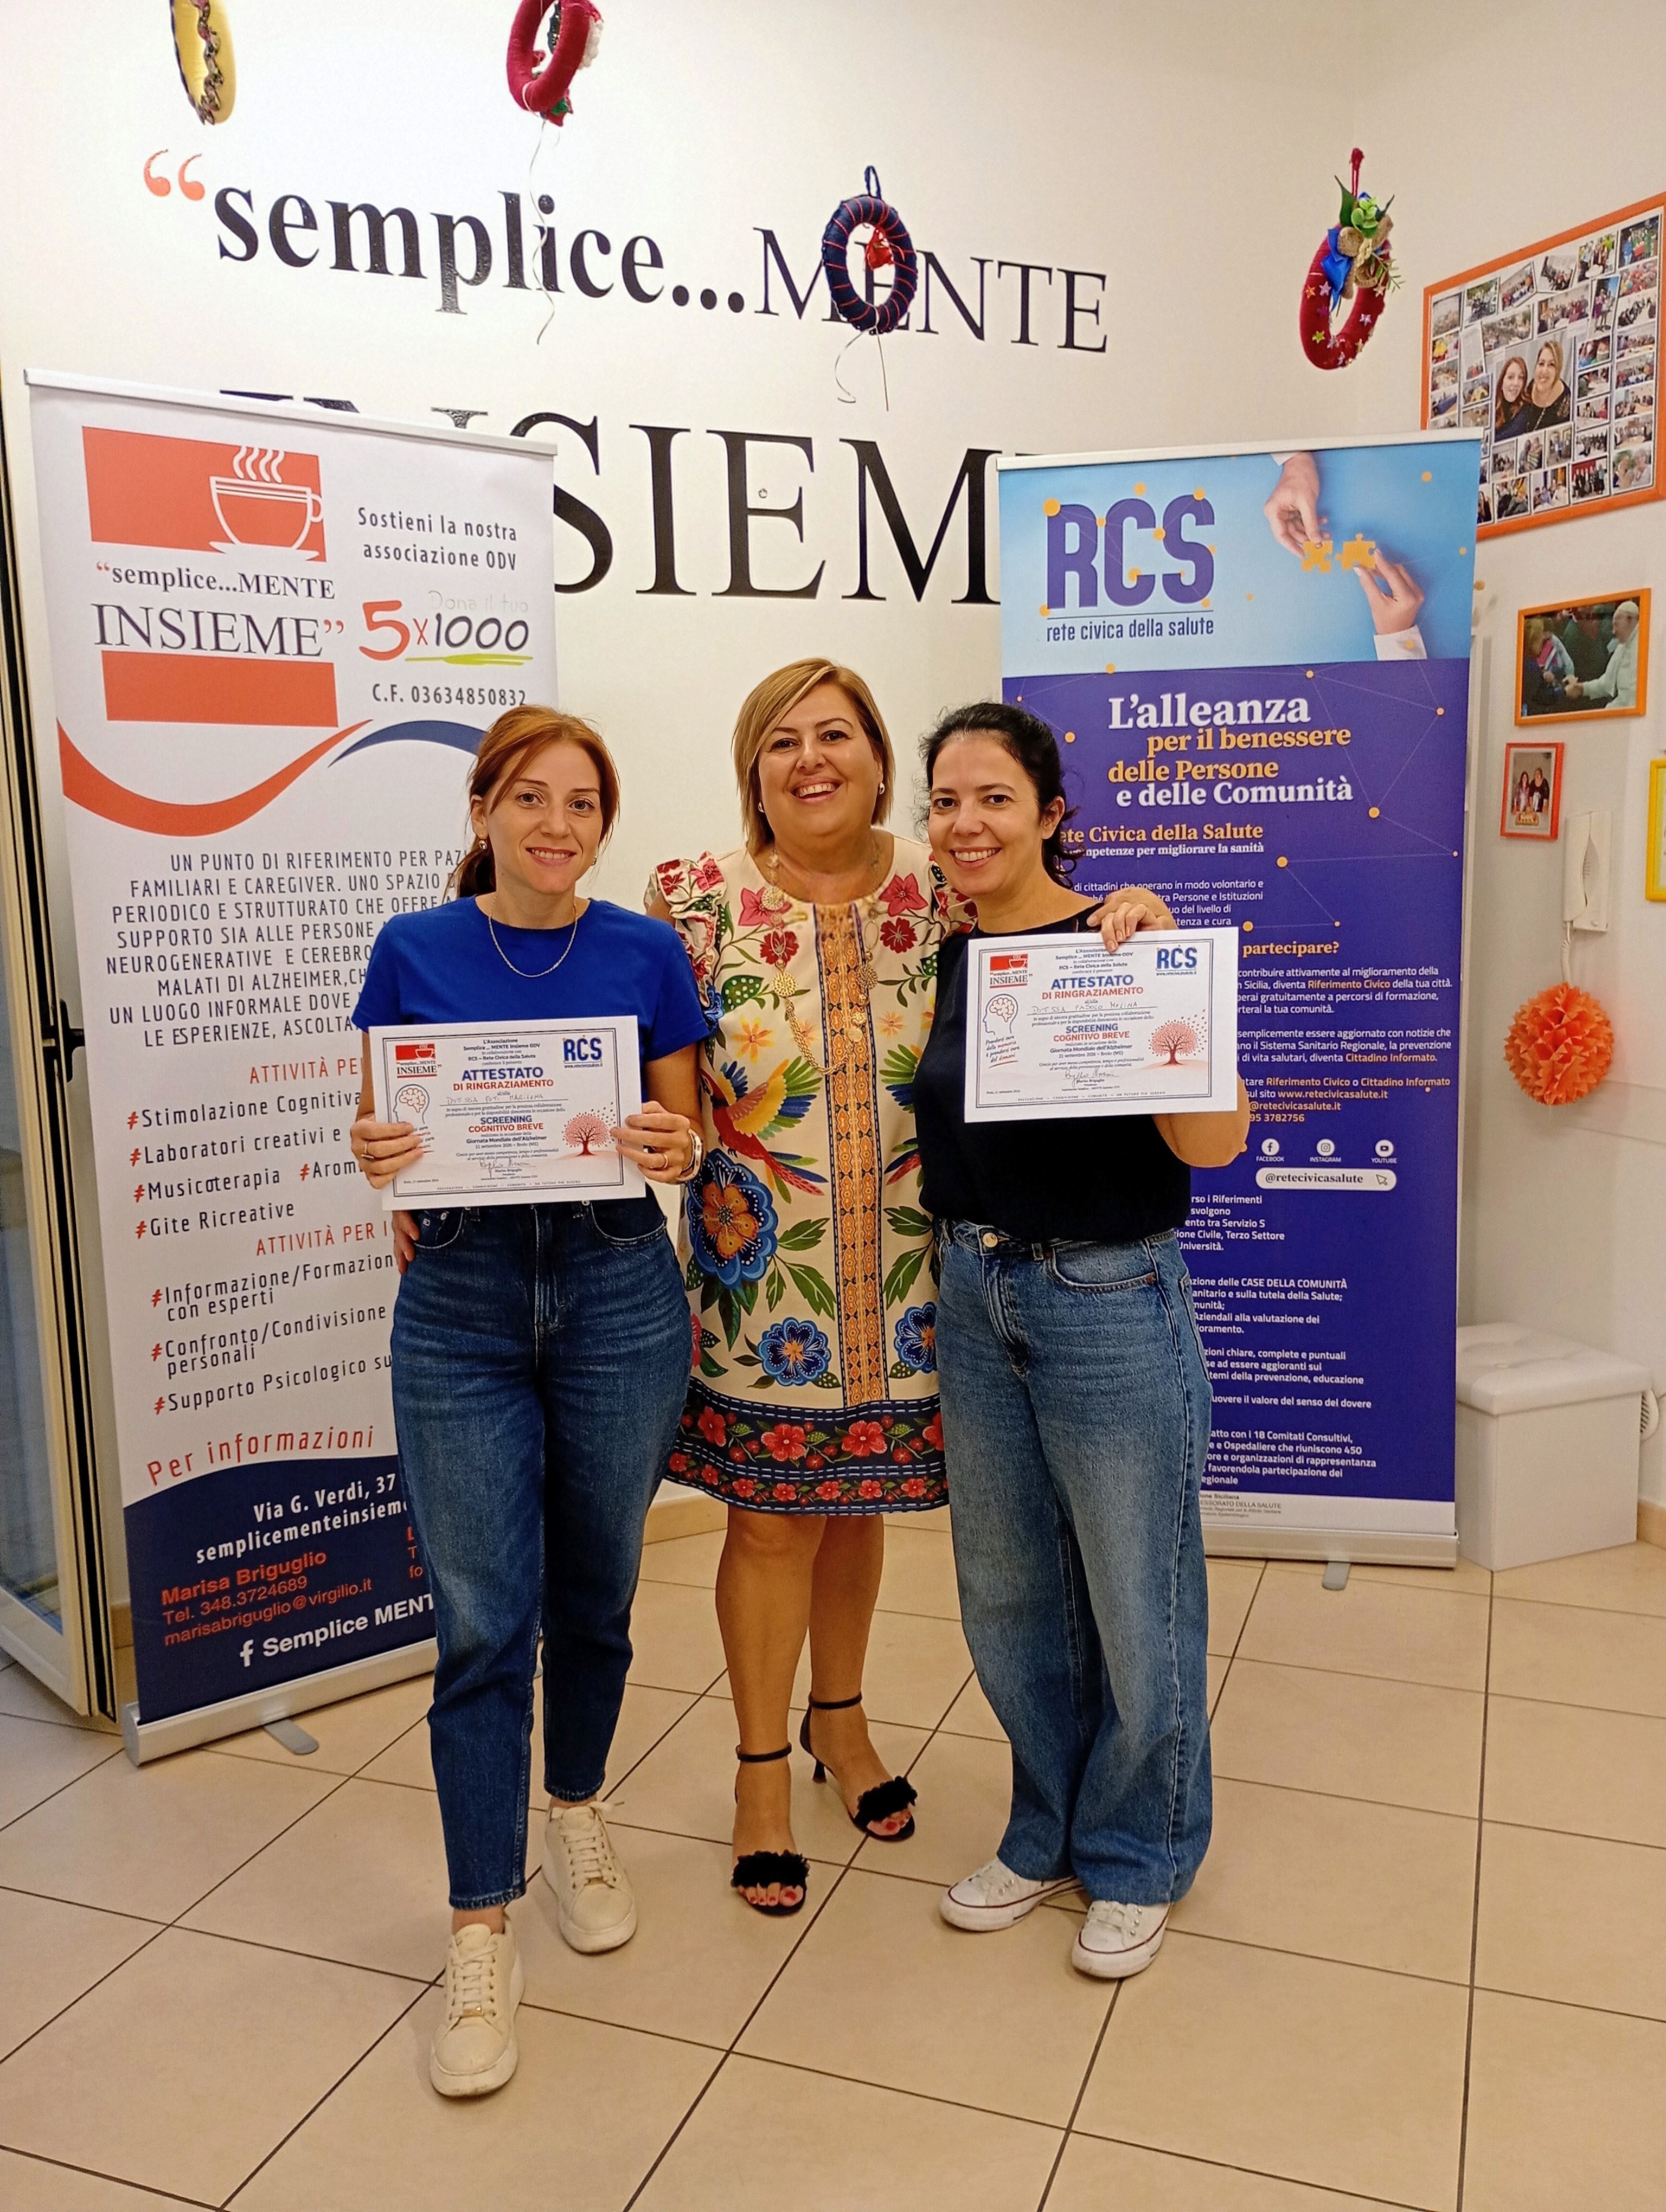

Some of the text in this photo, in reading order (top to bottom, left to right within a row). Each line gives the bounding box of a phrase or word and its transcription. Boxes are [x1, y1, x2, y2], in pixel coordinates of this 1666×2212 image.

[358, 507, 516, 541] Sostieni la nostra
[364, 544, 515, 570] associazione ODV
[1047, 490, 1214, 609] RCS
[428, 590, 529, 613] Dona il tuo
[1047, 617, 1213, 641] rete civica della salute
[373, 684, 526, 707] C.F. 03634850832
[1148, 728, 1350, 757] per il benessere
[1108, 760, 1278, 782] delle Persone
[1116, 775, 1353, 807] e delle Comunità
[1090, 823, 1263, 842] Civica della Salute
[171, 851, 427, 871] UN PUNTO DI RIFERIMENTO PER
[1137, 842, 1264, 857] per migliorare la sanità
[131, 873, 439, 897] FAMILIARI E CAREGIVER. UNO SPAZIO
[1074, 883, 1082, 892] di
[1084, 883, 1118, 891] cittadini
[1175, 880, 1182, 889] in
[1185, 880, 1209, 889] modo
[1212, 880, 1253, 888] volontario
[113, 897, 438, 923] PERIODICO E STRUTTURATO CHE OFFRE
[118, 922, 374, 948] SUPPORTO SIA ALLE PERSONE
[1157, 948, 1196, 968] RCS
[1243, 941, 1339, 957] partecipare?
[107, 949, 293, 974] NEUROGENERATIVE E
[1286, 967, 1438, 978] attivamente al miglioramento della
[158, 975, 243, 996] MALATI DI
[1052, 975, 1133, 990] ATTESTATO
[1055, 987, 1143, 999] RINGRAZIAMENTO
[1308, 980, 1361, 988] Riferimento
[1364, 980, 1390, 988] Civico
[1393, 979, 1413, 988] della
[110, 993, 350, 1024] UN LUOGO INFORMALE DOVE
[145, 1021, 275, 1047] LE ESPERIENZE,
[1054, 1033, 1099, 1041] COGNITIVO
[1066, 1024, 1118, 1033] SCREENING
[564, 1038, 601, 1060] RCS
[250, 1057, 328, 1084] ATTIVITÀ
[462, 1067, 543, 1081] ATTESTATO
[466, 1079, 553, 1090] RINGRAZIAMENTO
[1278, 1090, 1387, 1098] www.retecivicasalute.it
[277, 1091, 361, 1115] Cognitiva
[469, 1124, 514, 1133] COGNITIVO
[480, 1115, 532, 1125] SCREENING
[255, 1127, 323, 1150] creativi
[333, 1127, 341, 1141] e
[1266, 1173, 1363, 1183] @retecivicasalute
[200, 1203, 293, 1229] Ricreative
[1222, 1219, 1256, 1228] Servizio
[257, 1223, 375, 1256] ATTIVITÀ PER
[1226, 1231, 1285, 1240] Terzo Settore
[151, 1253, 394, 1308] #Informazione/Formazion
[1241, 1278, 1347, 1289] CASE DELLA COMUNITÀ
[168, 1288, 273, 1321] con esperti
[168, 1343, 257, 1380] personali
[264, 1360, 366, 1391] Psicologico
[1254, 1431, 1353, 1443] 18 Comitati Consultivi,
[148, 1426, 374, 1486] Per informazioni
[1344, 1446, 1362, 1455] 450
[254, 1474, 395, 1522] Via G. Verdi, 37
[162, 1551, 326, 1605] Marisa Briguglio
[163, 1576, 306, 1624] Tel. 348.3724689
[263, 1613, 368, 1656] Semplice
